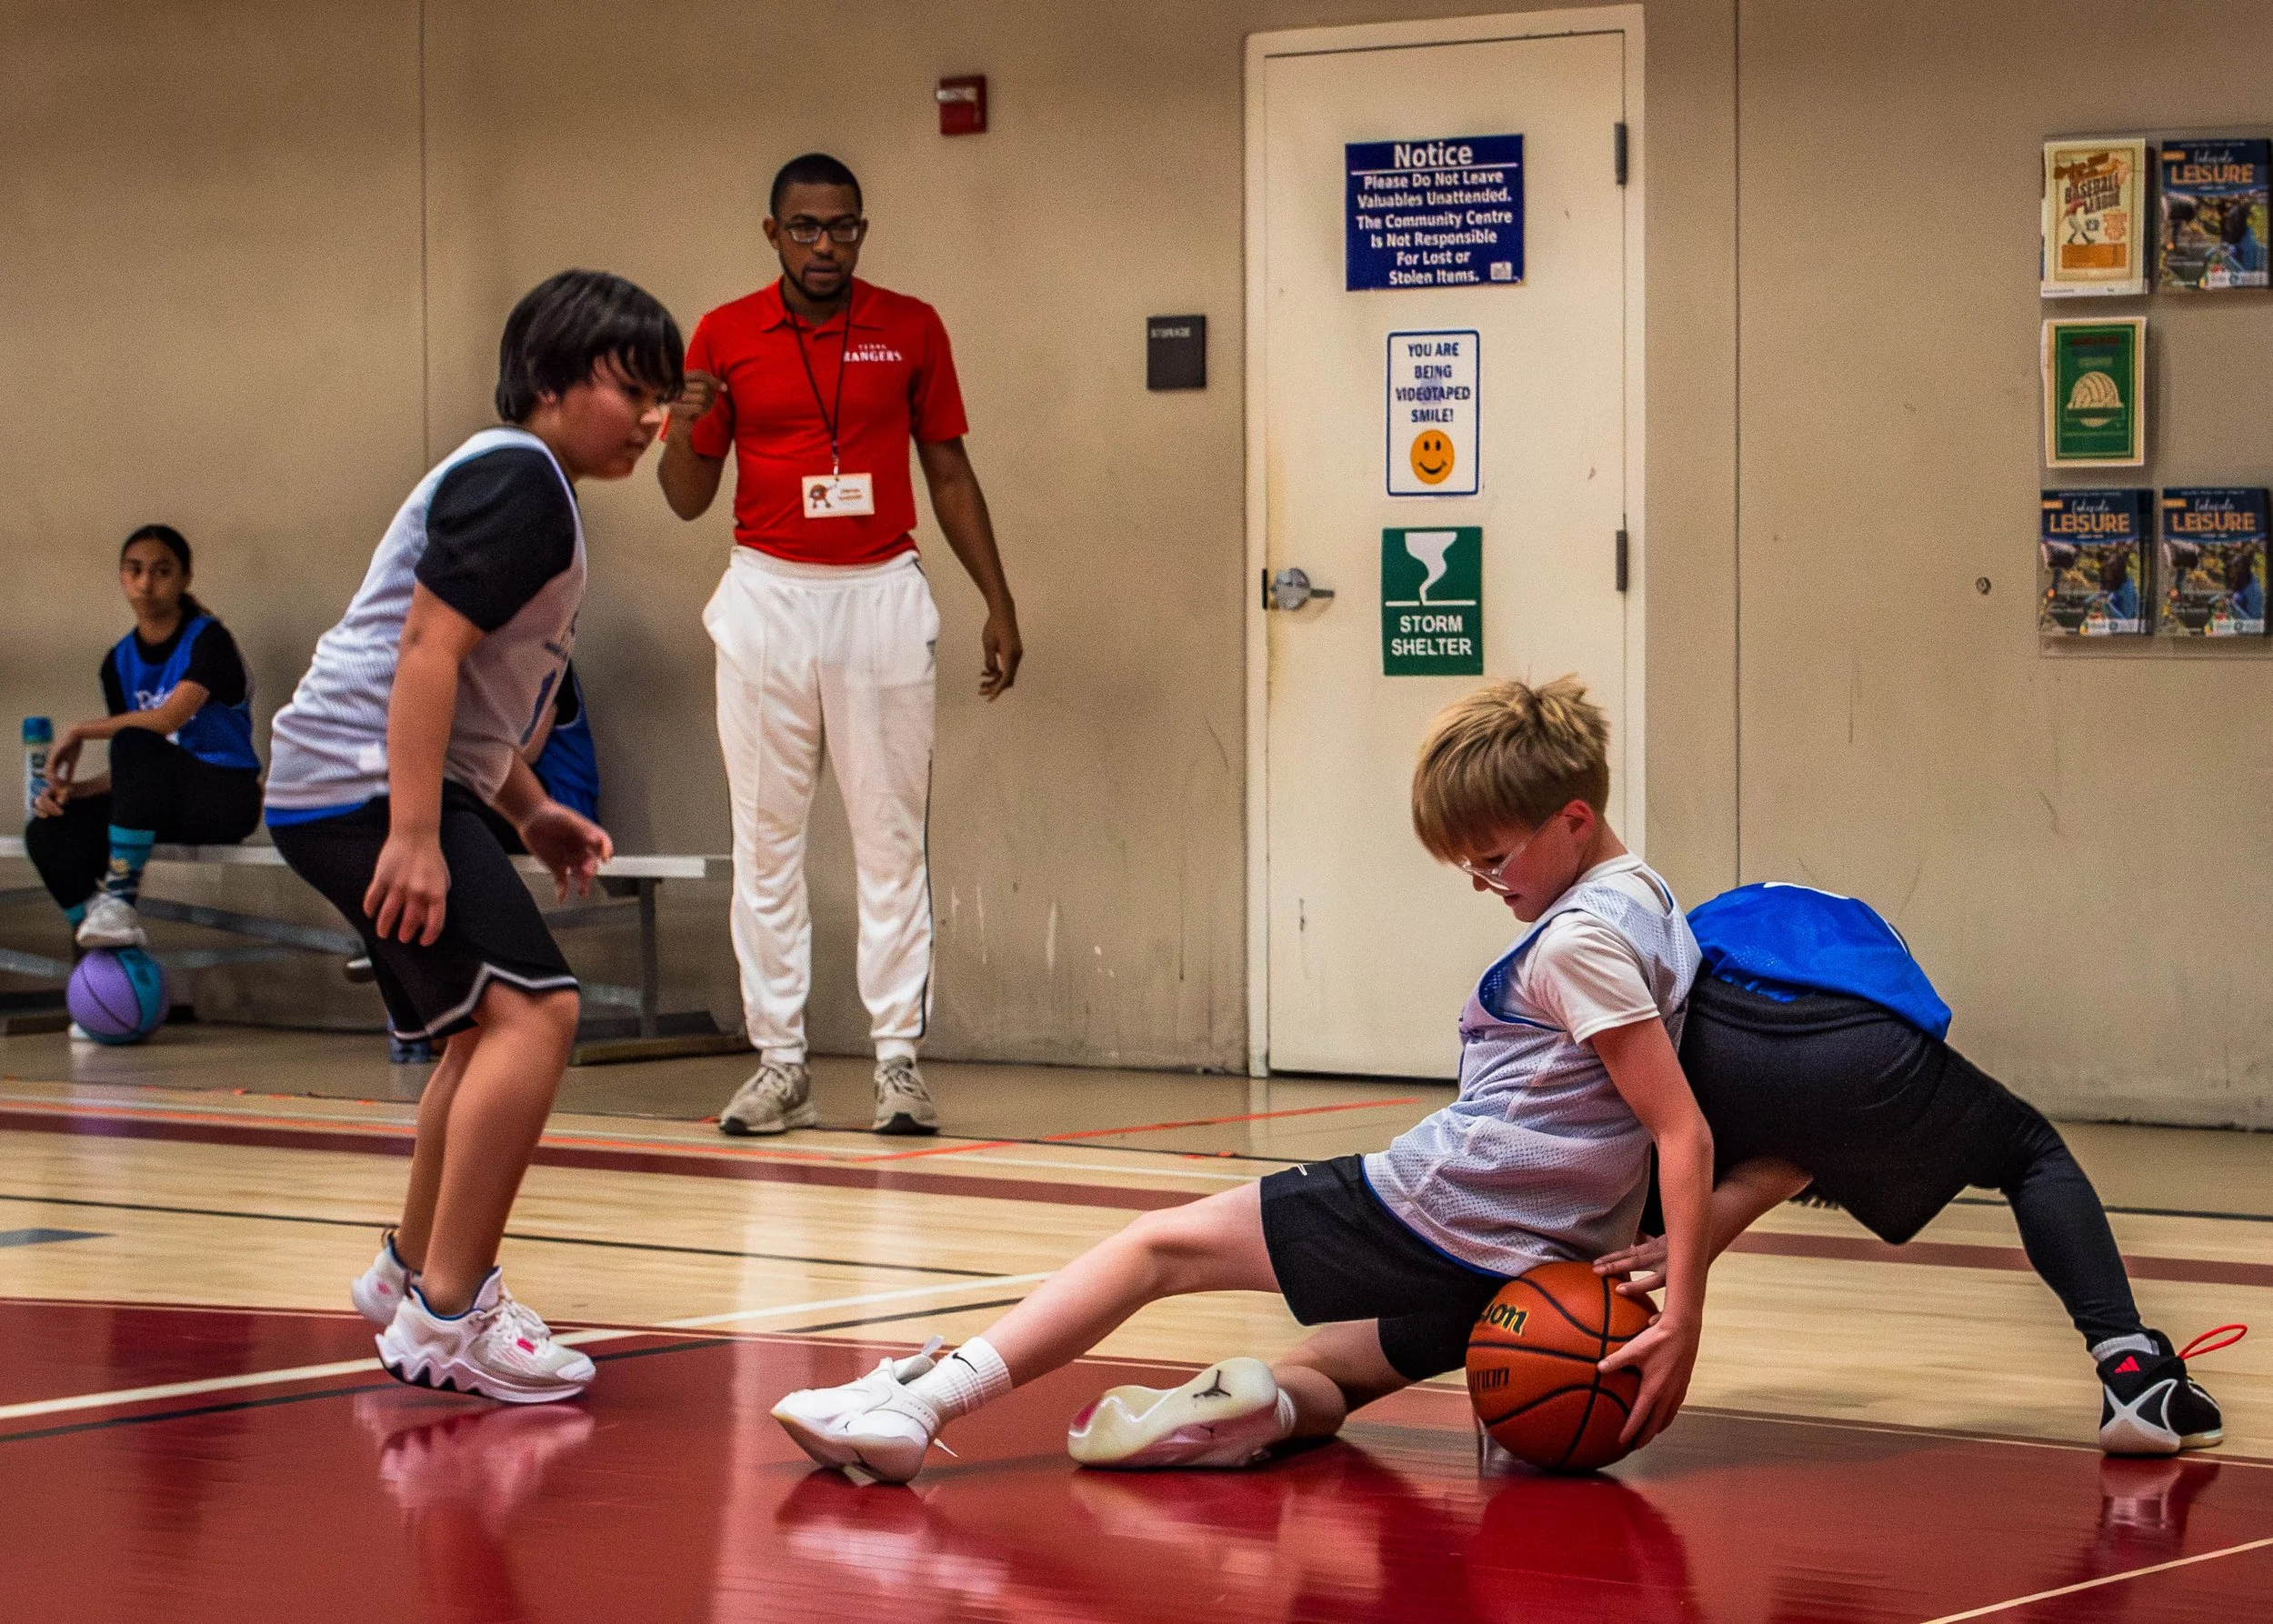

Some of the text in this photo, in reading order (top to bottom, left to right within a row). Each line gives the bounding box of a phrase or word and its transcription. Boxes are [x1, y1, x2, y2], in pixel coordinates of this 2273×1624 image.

[1394, 142, 1473, 168] Notice
[1364, 171, 1504, 189] Please Do Not Leave
[2170, 163, 2255, 185] LEISURE
[1357, 188, 1512, 208] Valuables Unattended.
[1357, 210, 1513, 230] The Community Centre
[1371, 229, 1497, 248] Is Not Responsible
[1397, 250, 1471, 266] For Lost or
[1389, 268, 1480, 286] Stolen Items.
[843, 350, 903, 362] RANGERS
[1407, 342, 1459, 357] YOU ARE
[1415, 365, 1453, 379] BEING
[1395, 386, 1470, 401] VIDEOTAPED
[1411, 408, 1454, 423] SMILE!
[2049, 514, 2130, 533] LEISURE
[2172, 512, 2256, 532] LEISURE
[1399, 615, 1463, 634] STORM
[1391, 637, 1473, 656] SHELTER
